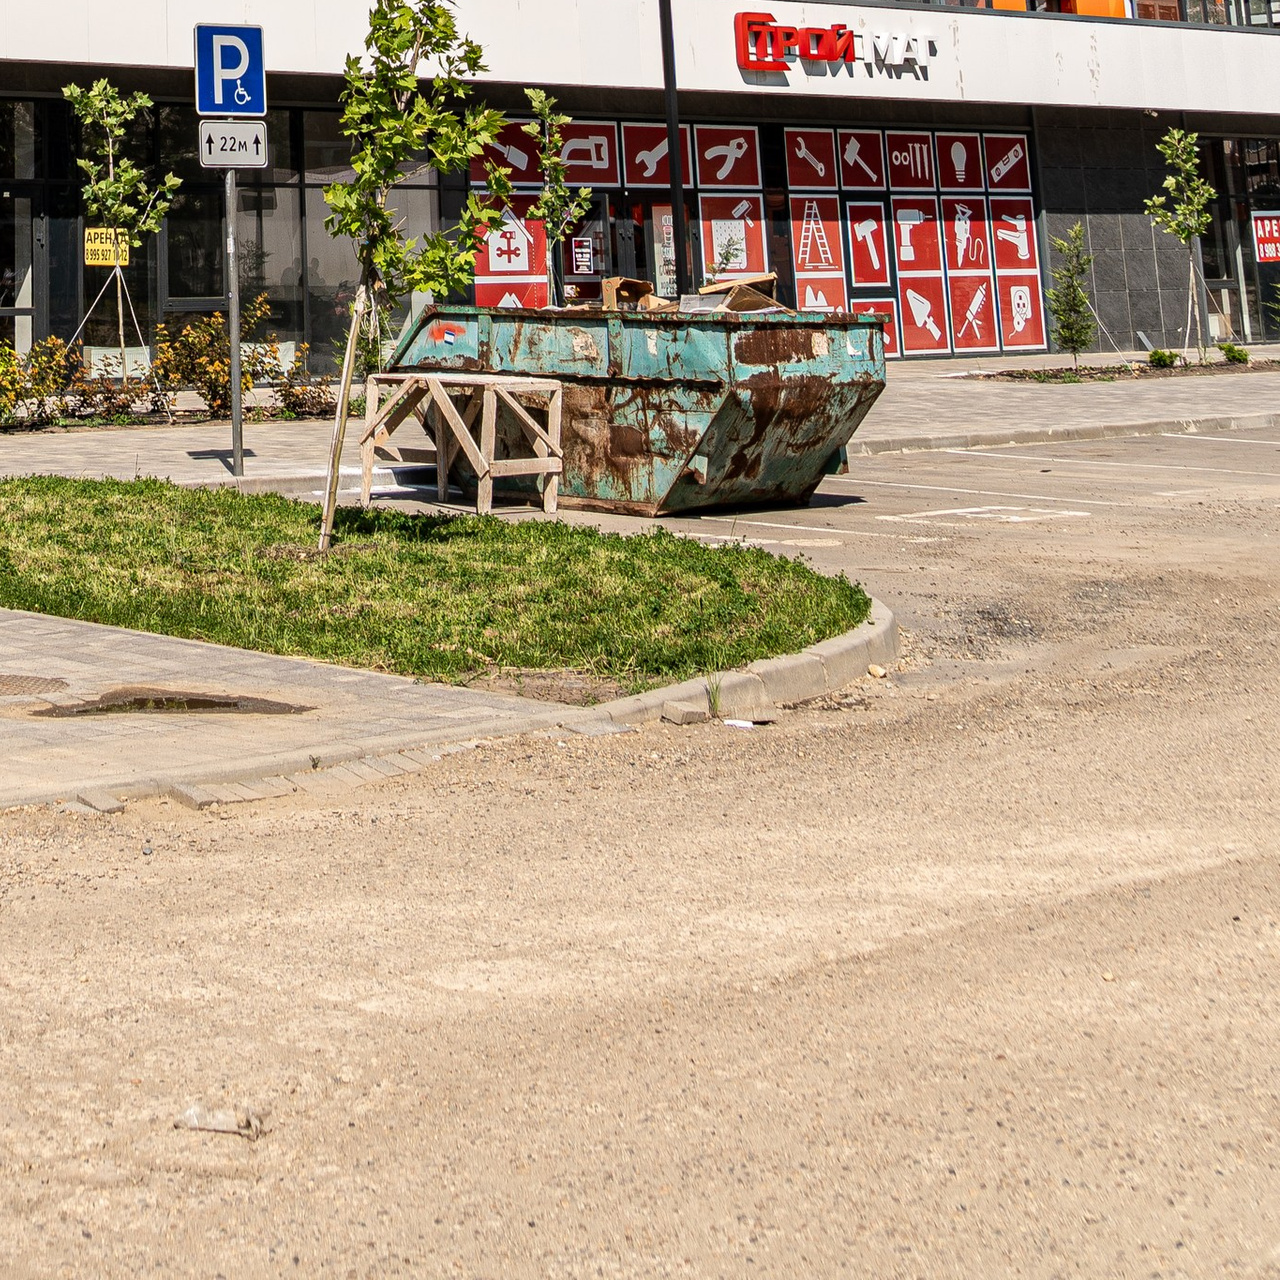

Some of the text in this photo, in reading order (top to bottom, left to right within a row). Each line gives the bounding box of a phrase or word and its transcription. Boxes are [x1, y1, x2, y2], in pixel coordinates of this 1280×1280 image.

[212, 34, 250, 105] P
[734, 12, 940, 71] СТРОЙ МАГ
[1257, 219, 1280, 238] АРЕ
